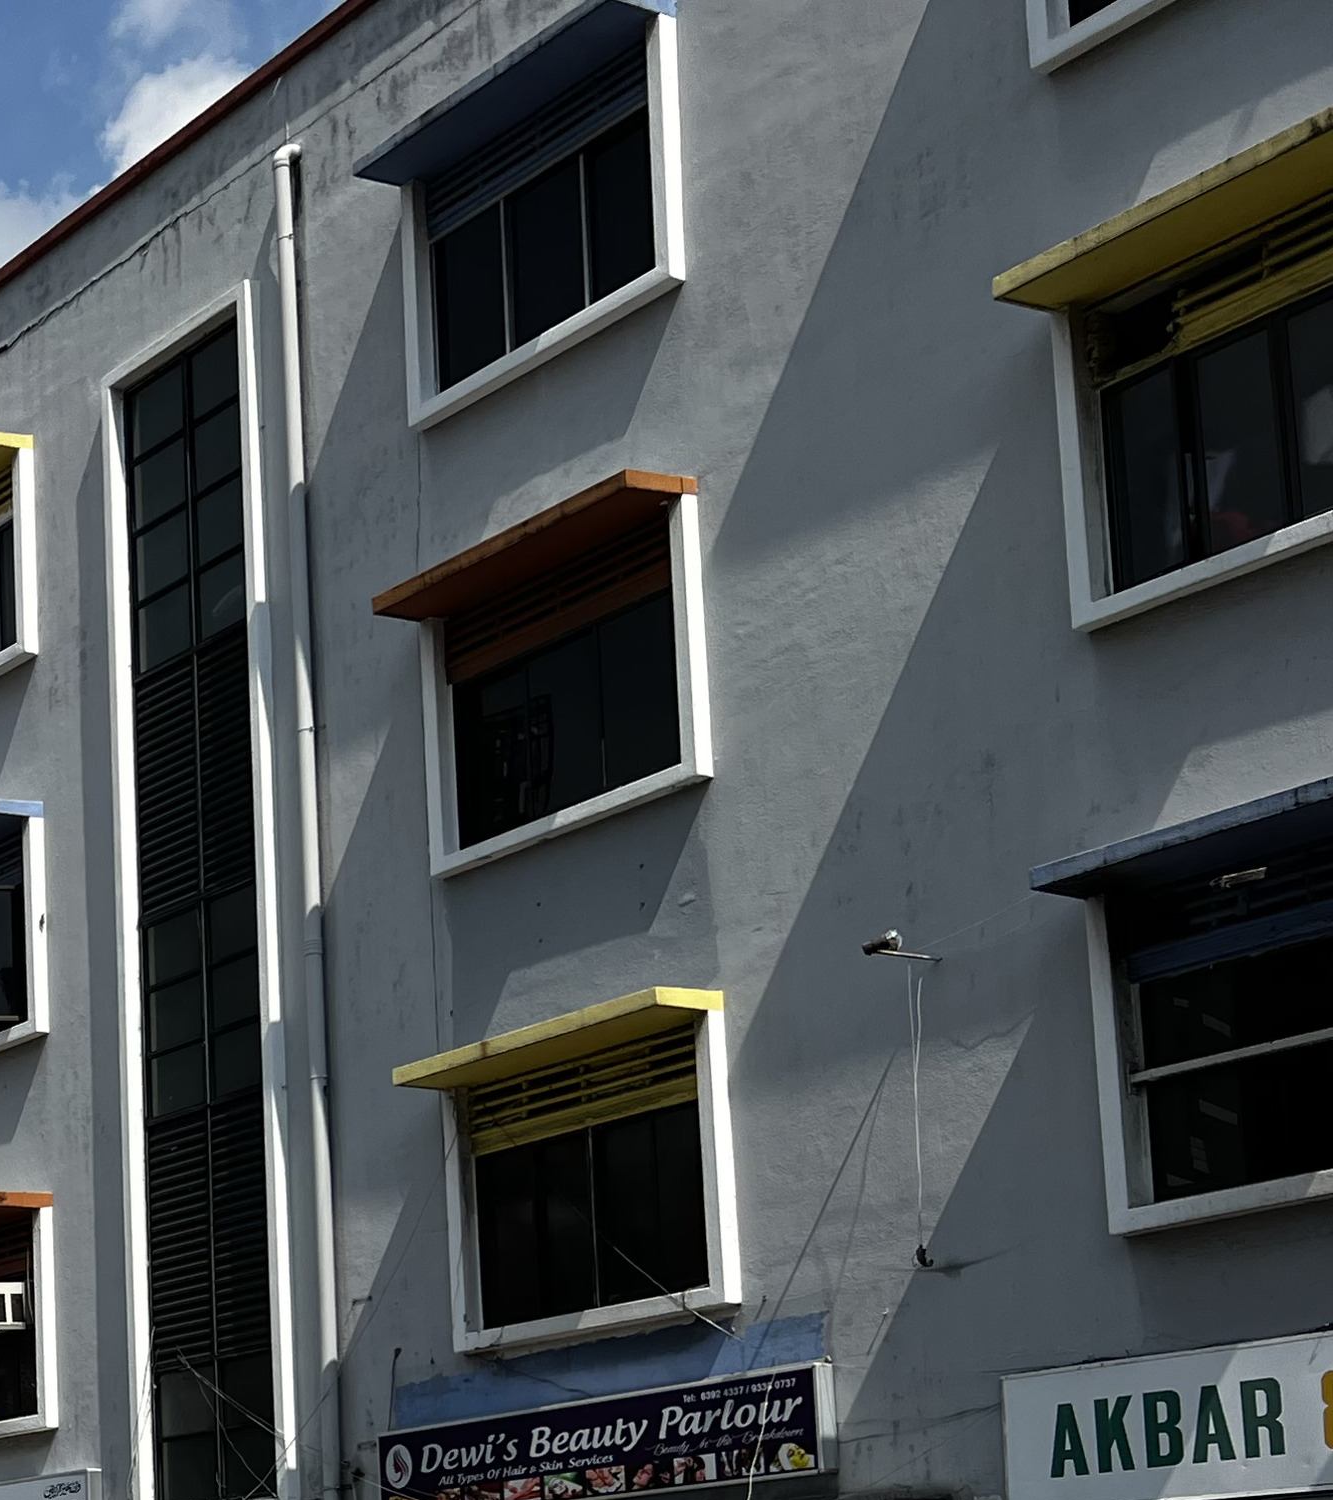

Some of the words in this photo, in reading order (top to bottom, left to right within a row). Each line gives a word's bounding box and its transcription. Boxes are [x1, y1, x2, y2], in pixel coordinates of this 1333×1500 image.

[420, 1433, 519, 1474] Dewi's
[529, 1418, 649, 1459] Beauty
[659, 1396, 803, 1440] Parlour
[1050, 1377, 1286, 1478] AKBAR
[438, 1474, 455, 1486] All
[457, 1471, 484, 1485] Types
[486, 1468, 502, 1480] Of
[503, 1465, 527, 1478] Hair
[539, 1460, 564, 1473] Skin
[568, 1454, 614, 1469] Services
